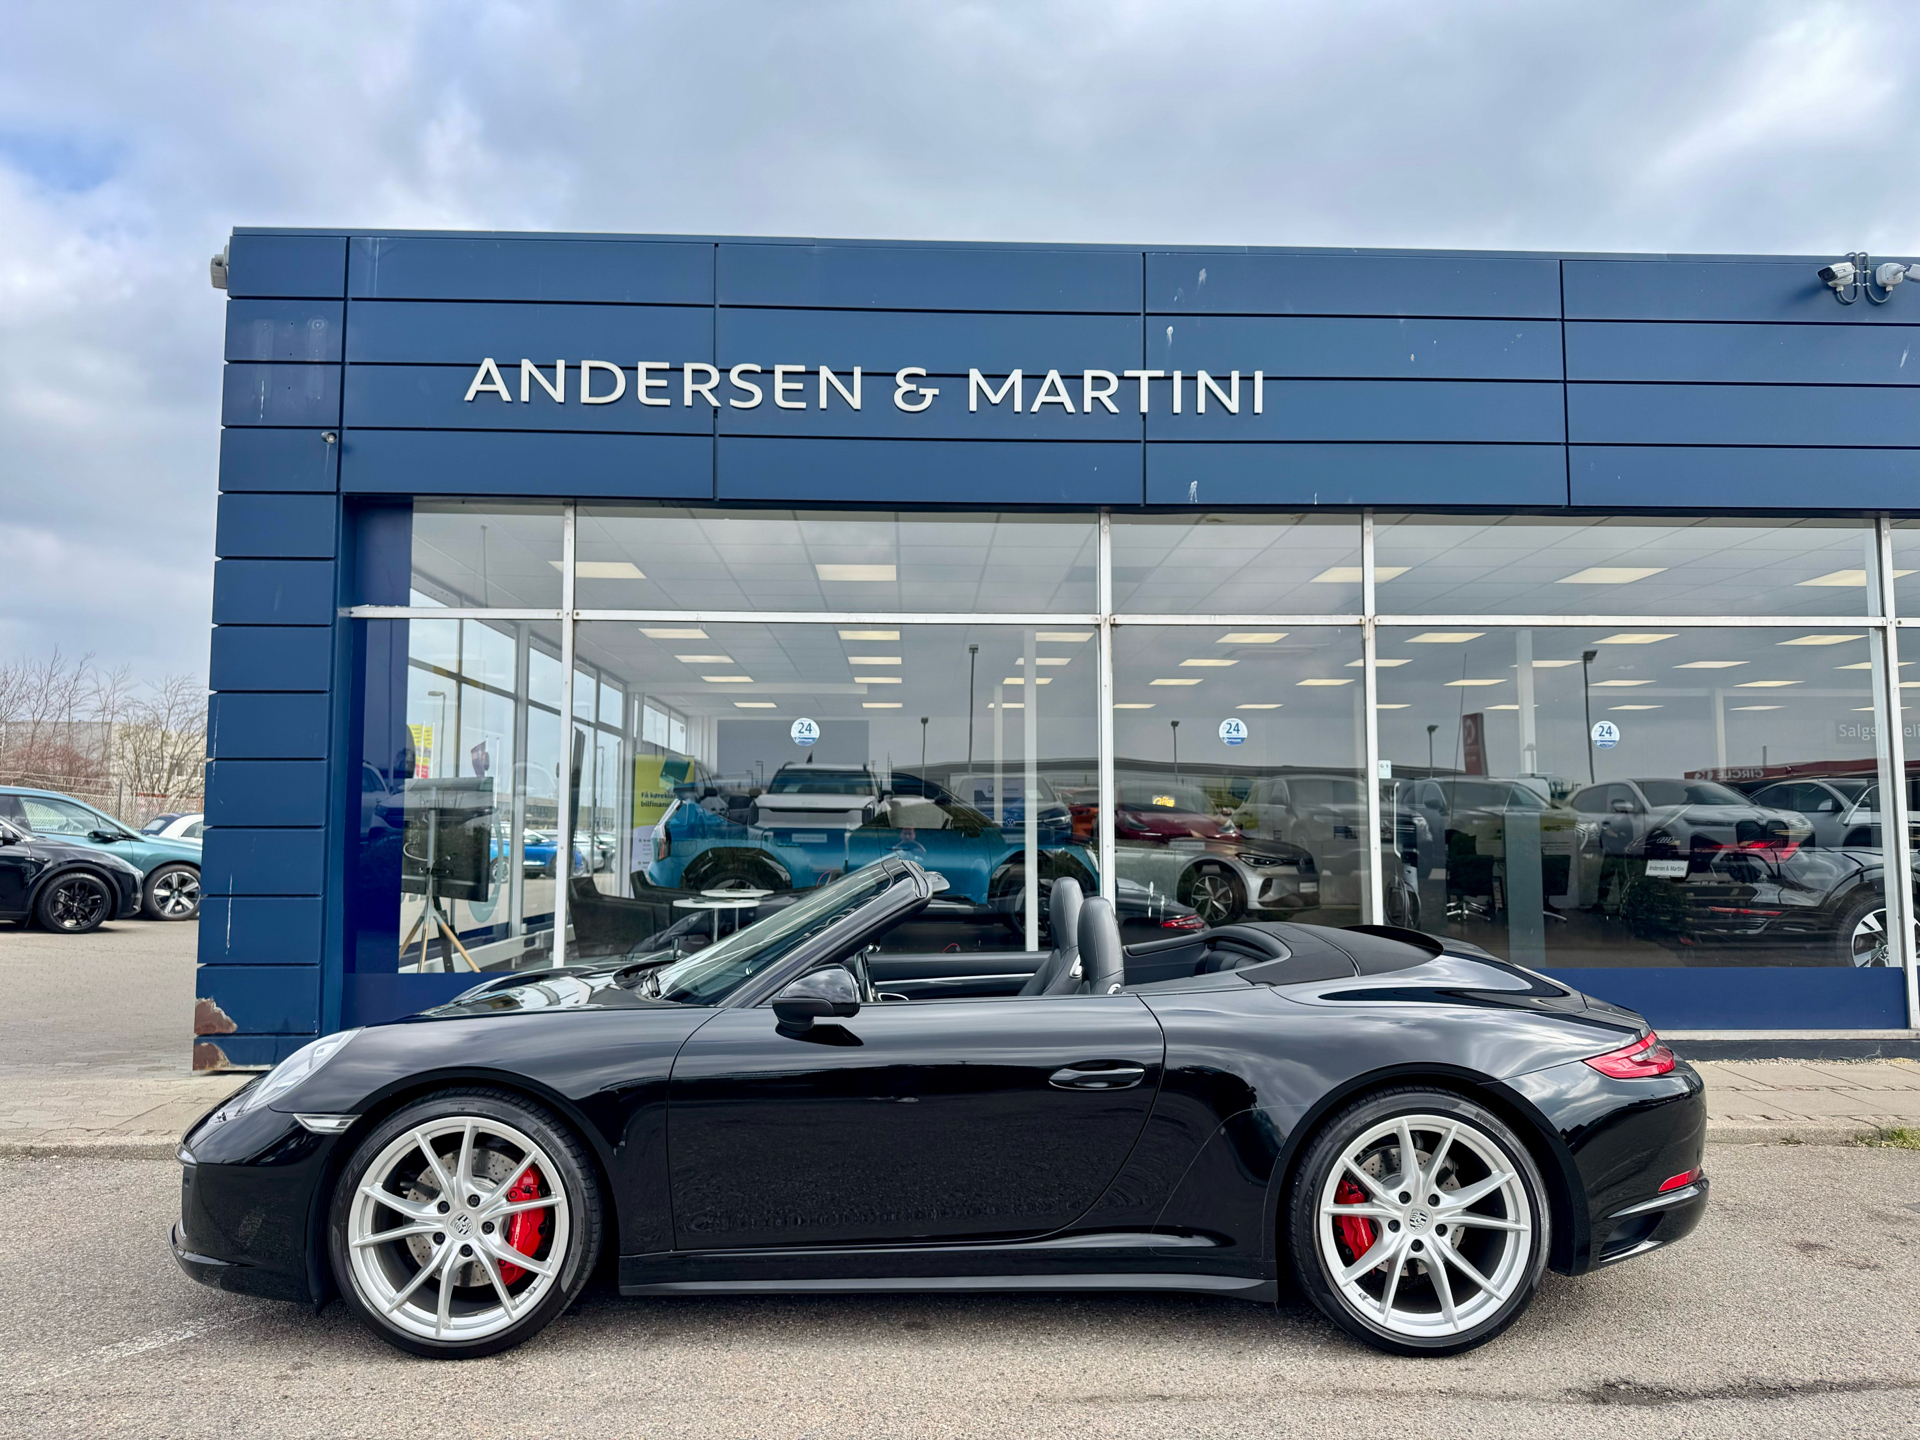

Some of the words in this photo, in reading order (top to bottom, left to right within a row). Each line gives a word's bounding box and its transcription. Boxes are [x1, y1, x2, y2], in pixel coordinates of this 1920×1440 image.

[463, 357, 862, 411] ANDERSEN
[893, 366, 940, 412] &
[968, 368, 1263, 414] MARTINI
[797, 721, 813, 735] 24
[1225, 722, 1240, 735] 24
[1598, 725, 1613, 737] 24
